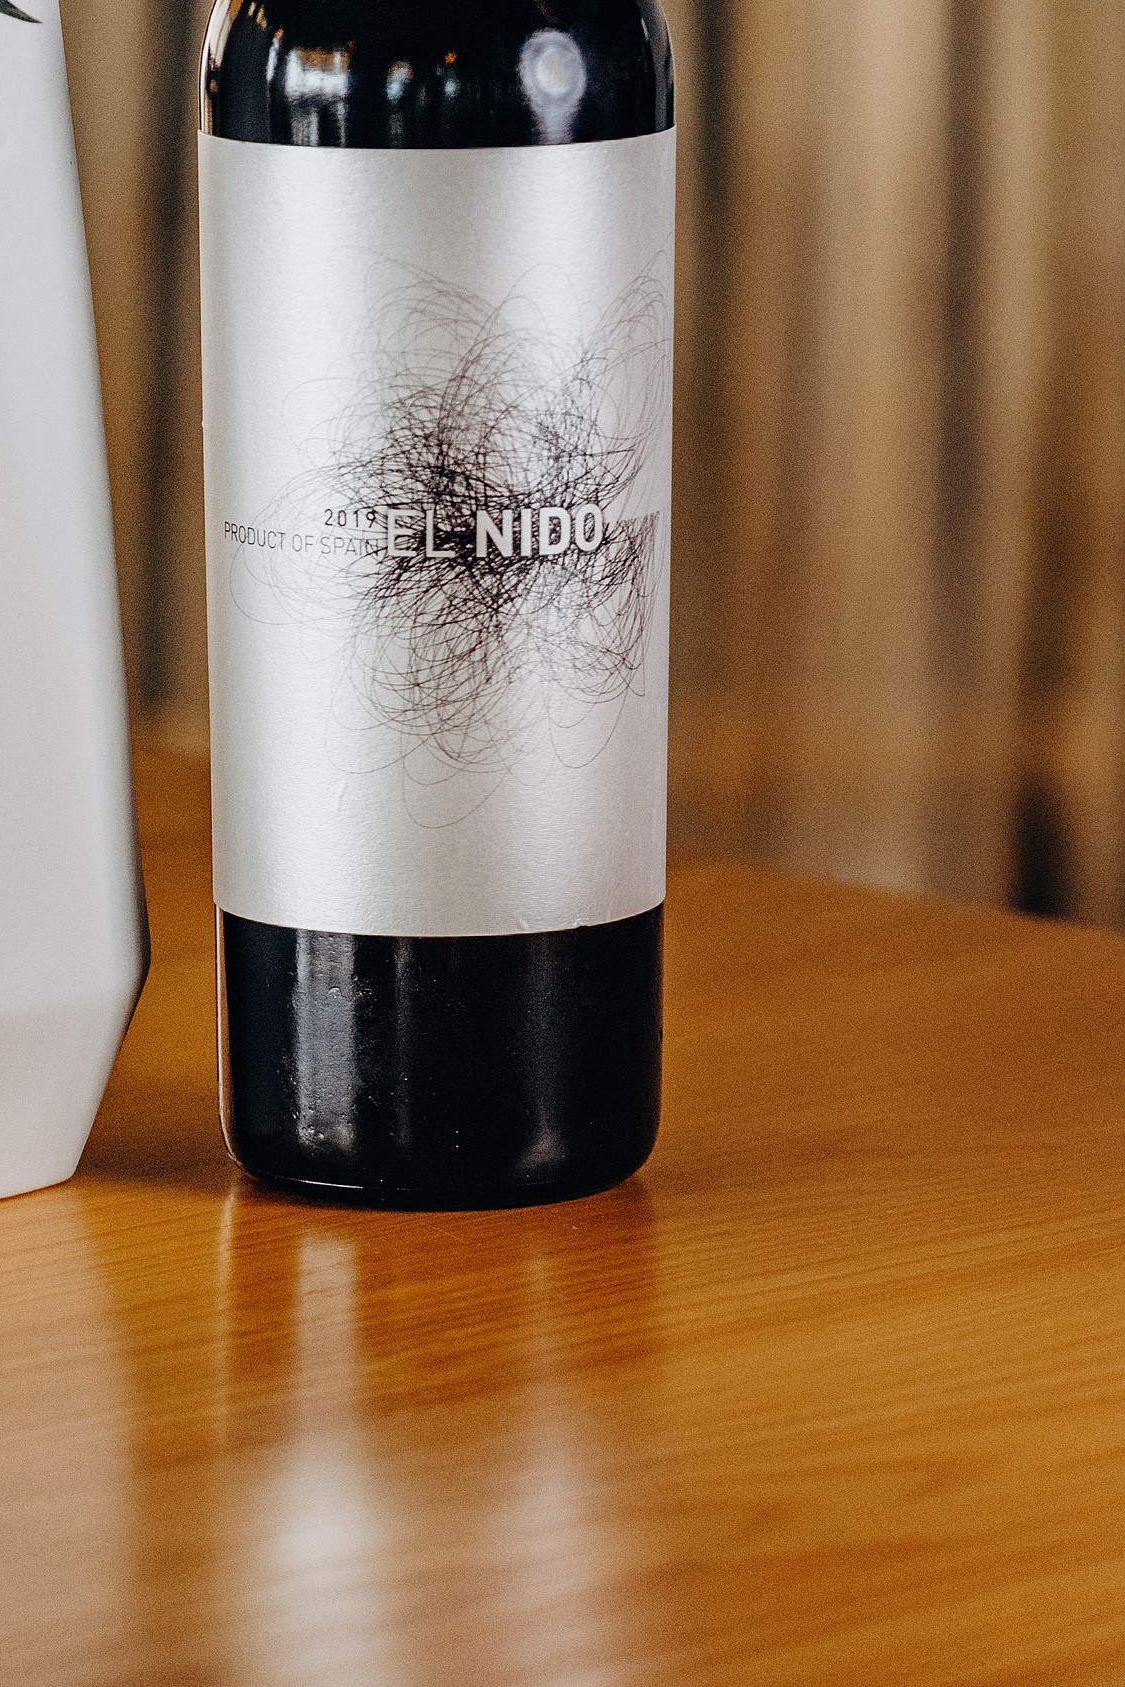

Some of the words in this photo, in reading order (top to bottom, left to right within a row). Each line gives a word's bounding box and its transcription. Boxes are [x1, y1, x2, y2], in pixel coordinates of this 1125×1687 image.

[324, 508, 376, 528] 2019
[387, 506, 456, 558] EL
[476, 504, 603, 557] NIDO
[224, 521, 286, 551] PRODUCT
[291, 533, 314, 552] OF
[320, 537, 379, 556] SPAIN
